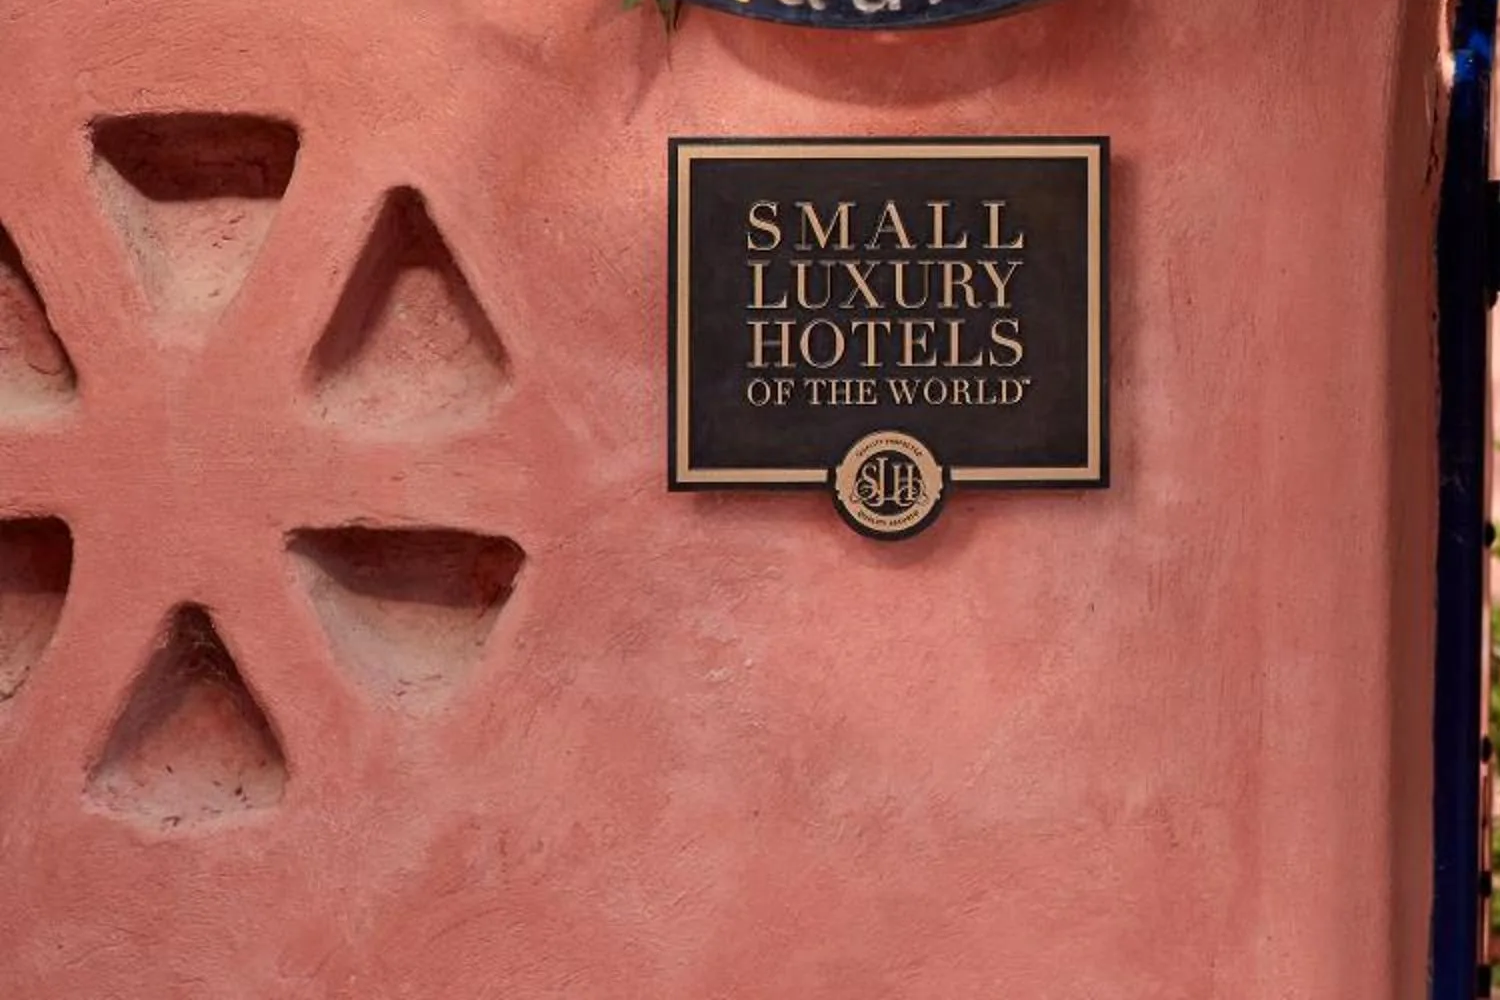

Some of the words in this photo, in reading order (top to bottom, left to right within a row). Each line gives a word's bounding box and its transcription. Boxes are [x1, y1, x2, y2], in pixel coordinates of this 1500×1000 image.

[747, 200, 1025, 250] SMALL
[746, 261, 1023, 309] LUXURY
[746, 318, 1024, 368] HOTELS
[747, 379, 796, 406] OF
[804, 380, 877, 405] THE
